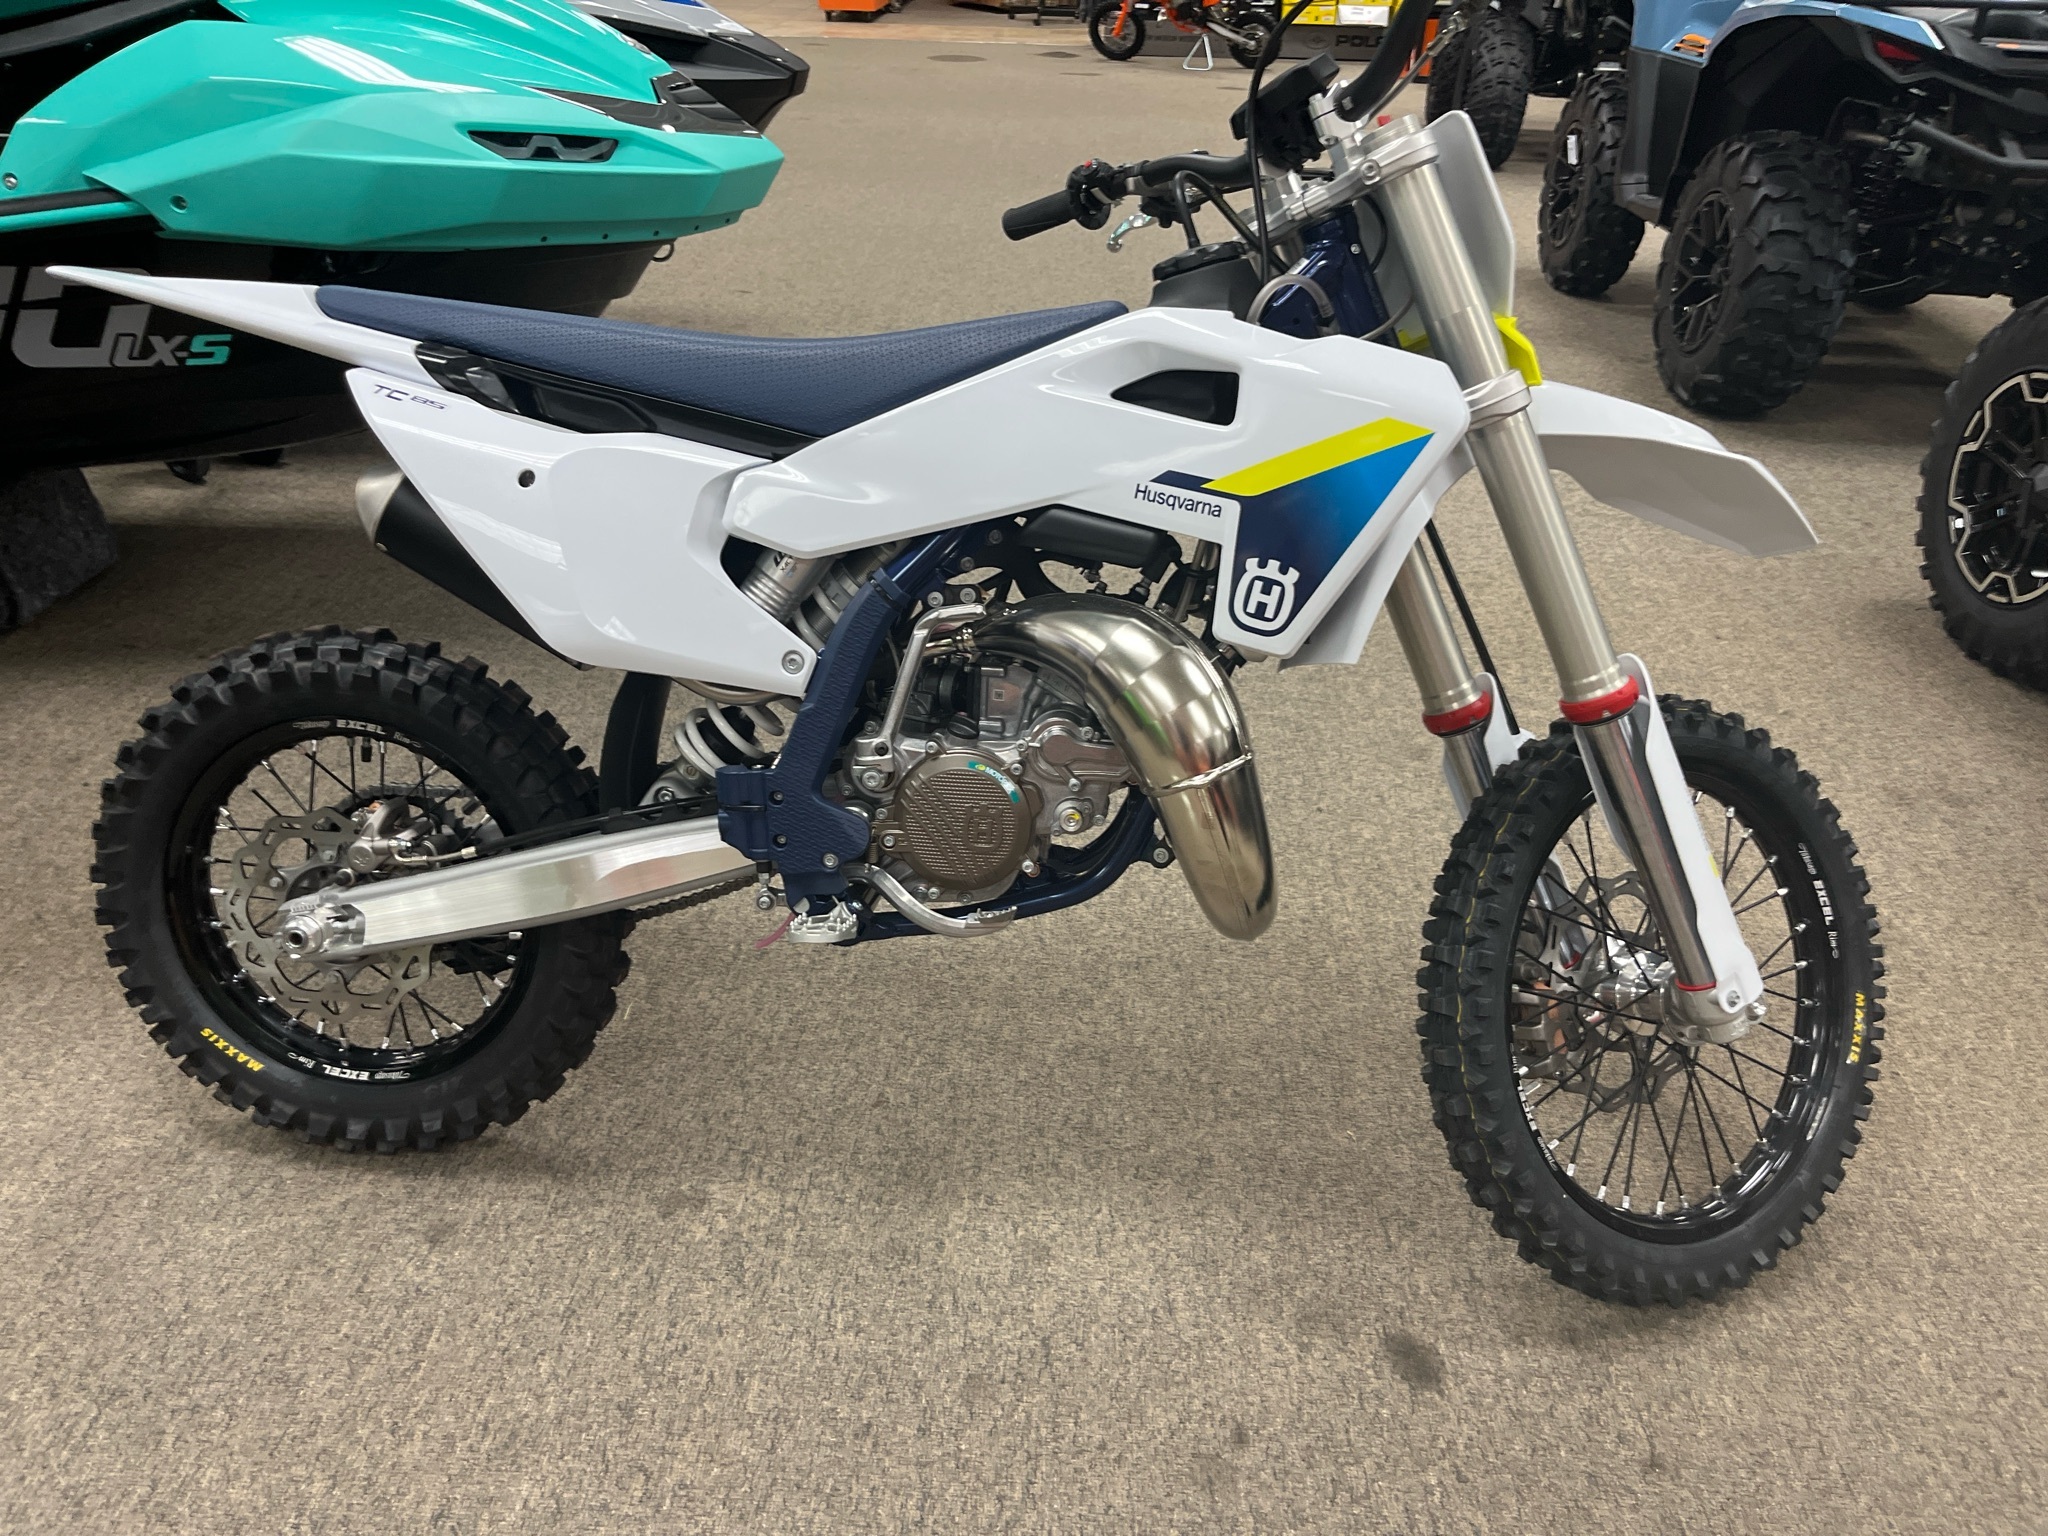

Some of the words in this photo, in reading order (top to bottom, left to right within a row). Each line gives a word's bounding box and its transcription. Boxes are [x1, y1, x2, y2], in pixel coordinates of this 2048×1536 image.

[374, 384, 410, 401] TC
[410, 395, 448, 409] 85
[1134, 483, 1222, 518] Husqvarna
[336, 719, 386, 735] EXCEL
[1813, 880, 1834, 926] EXCEL
[1849, 991, 1866, 1064] MAXXIS
[200, 1028, 265, 1072] MAXXIS
[322, 1064, 371, 1080] EXCEL
